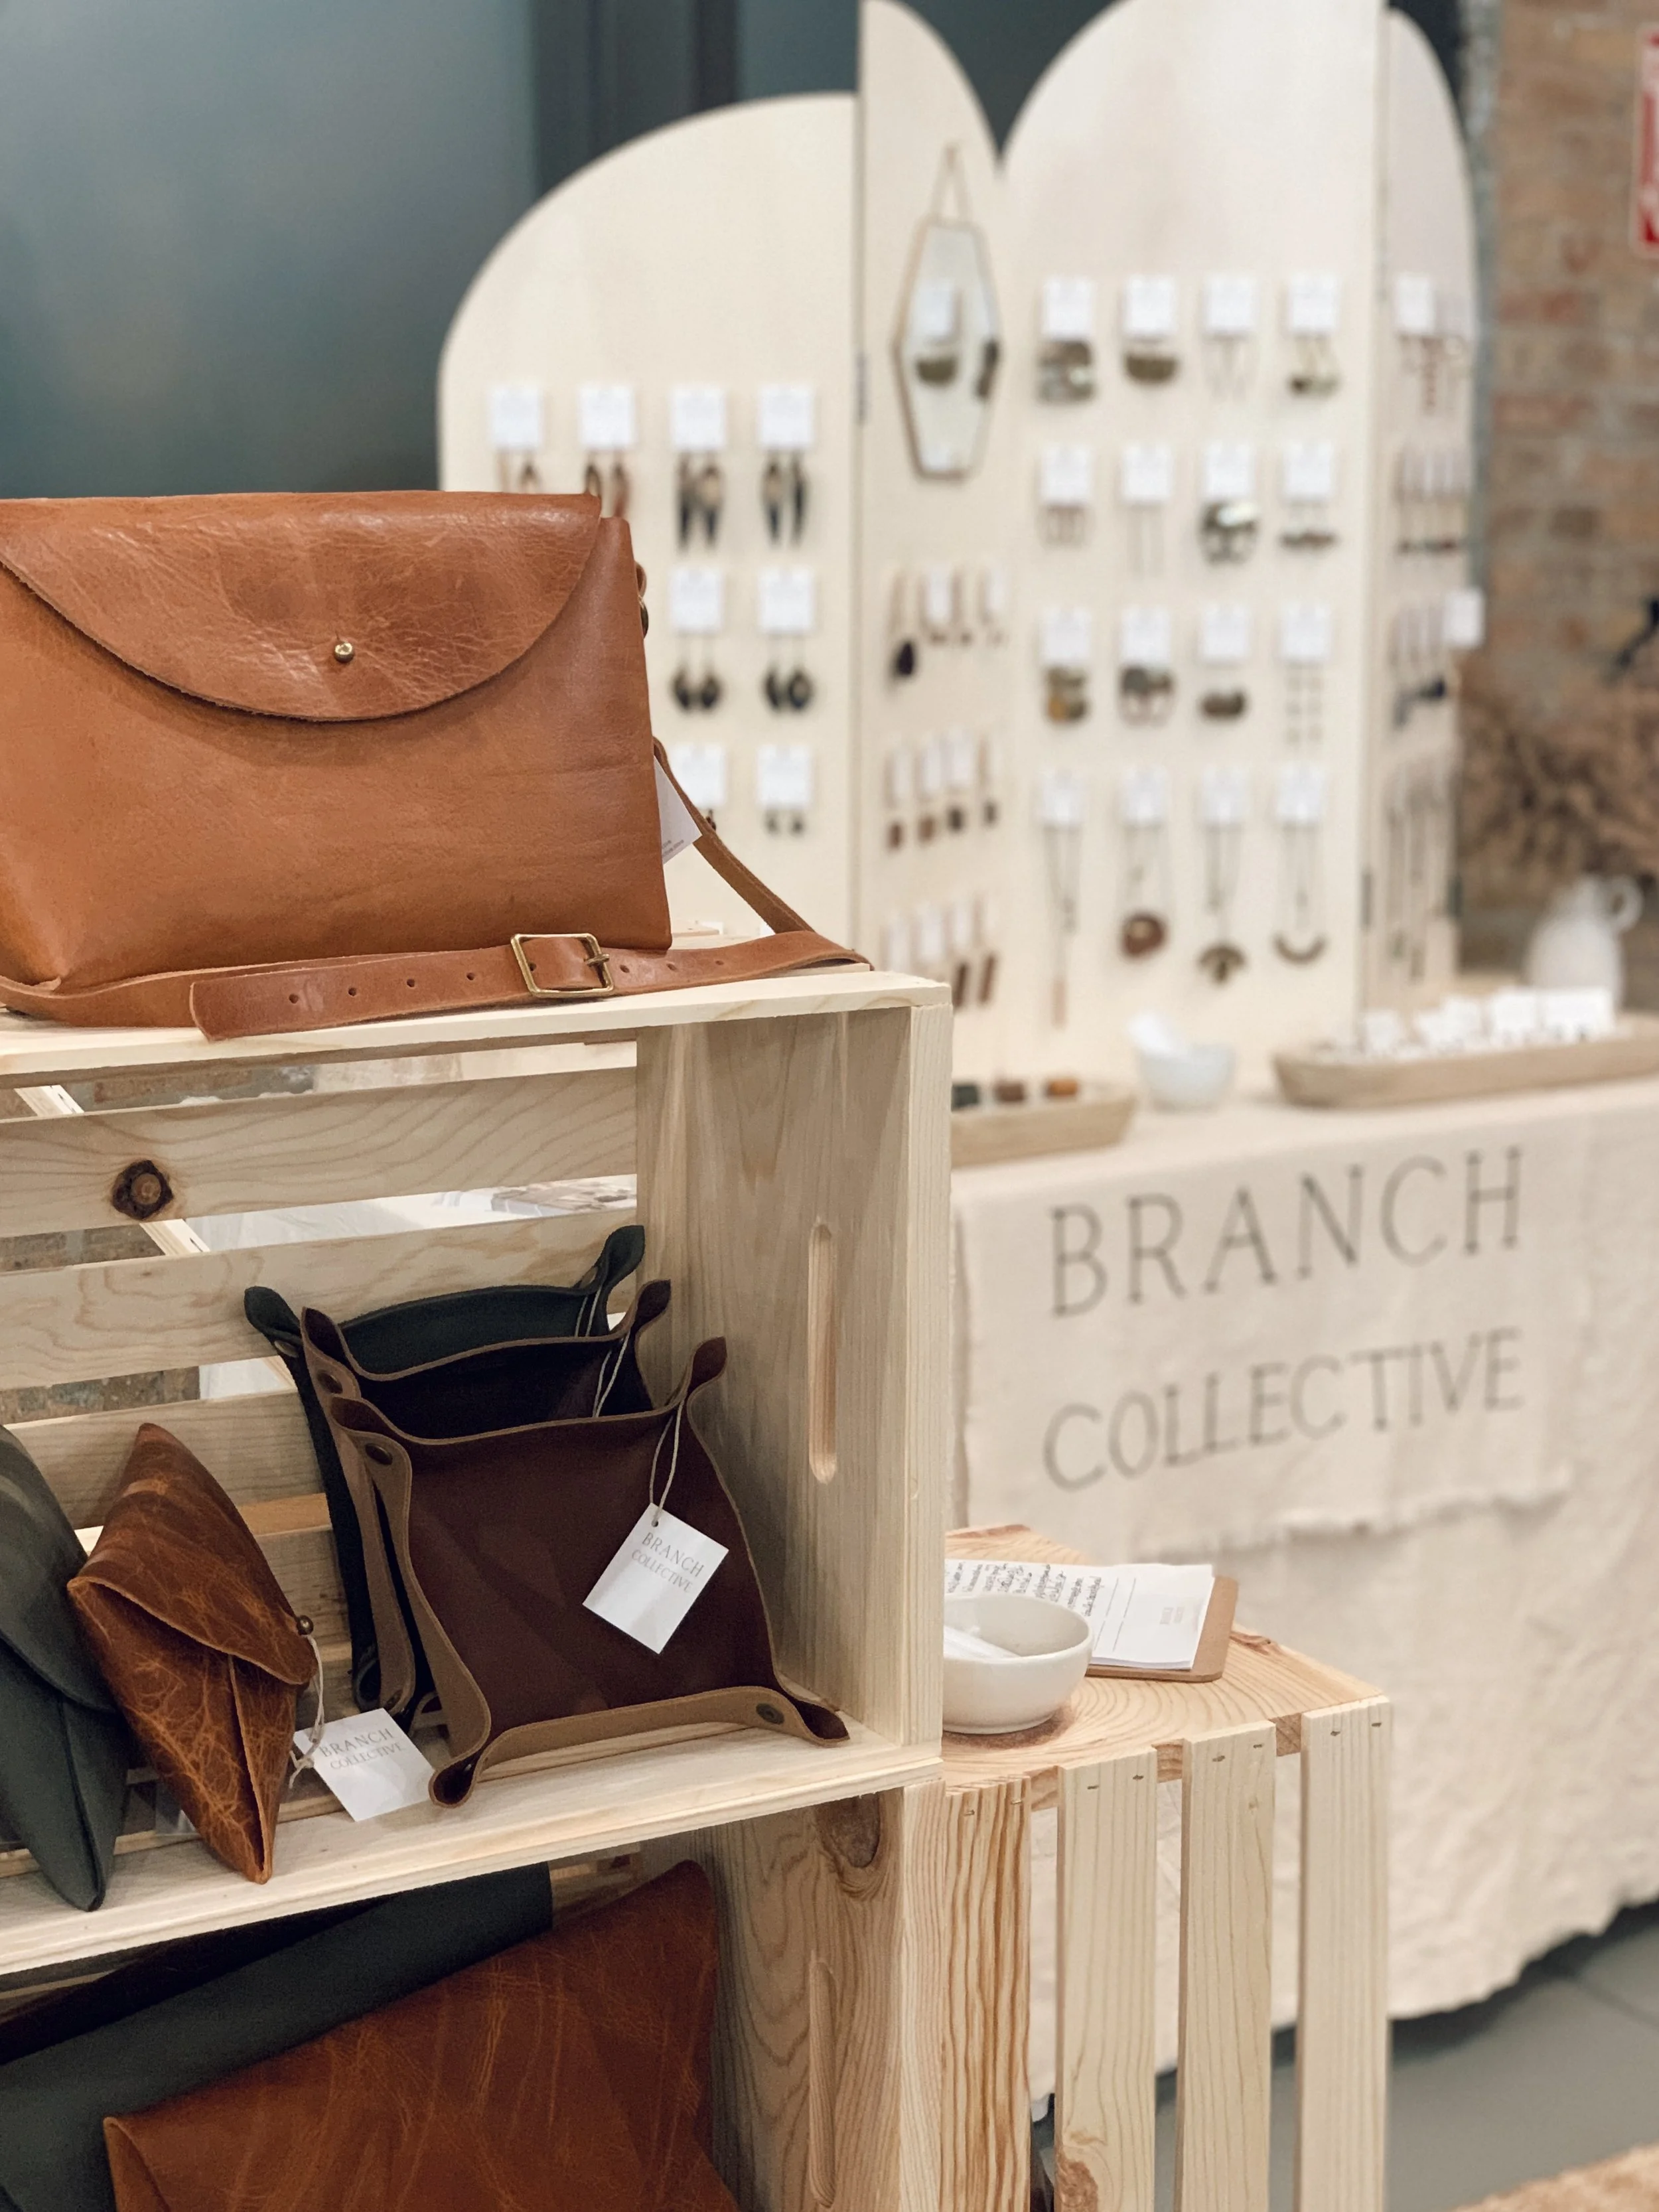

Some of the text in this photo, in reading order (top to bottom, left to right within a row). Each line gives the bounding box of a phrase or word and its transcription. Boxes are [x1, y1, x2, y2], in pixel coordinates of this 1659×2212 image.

[1050, 1145, 1523, 1319] BRANCH
[1043, 1326, 1526, 1491] COLLECTIVE
[631, 1549, 693, 1592] COLLECTIVE
[642, 1532, 705, 1577] BRANCH
[319, 1728, 395, 1758] BRANCH
[330, 1742, 403, 1770] COLLECTIVE
